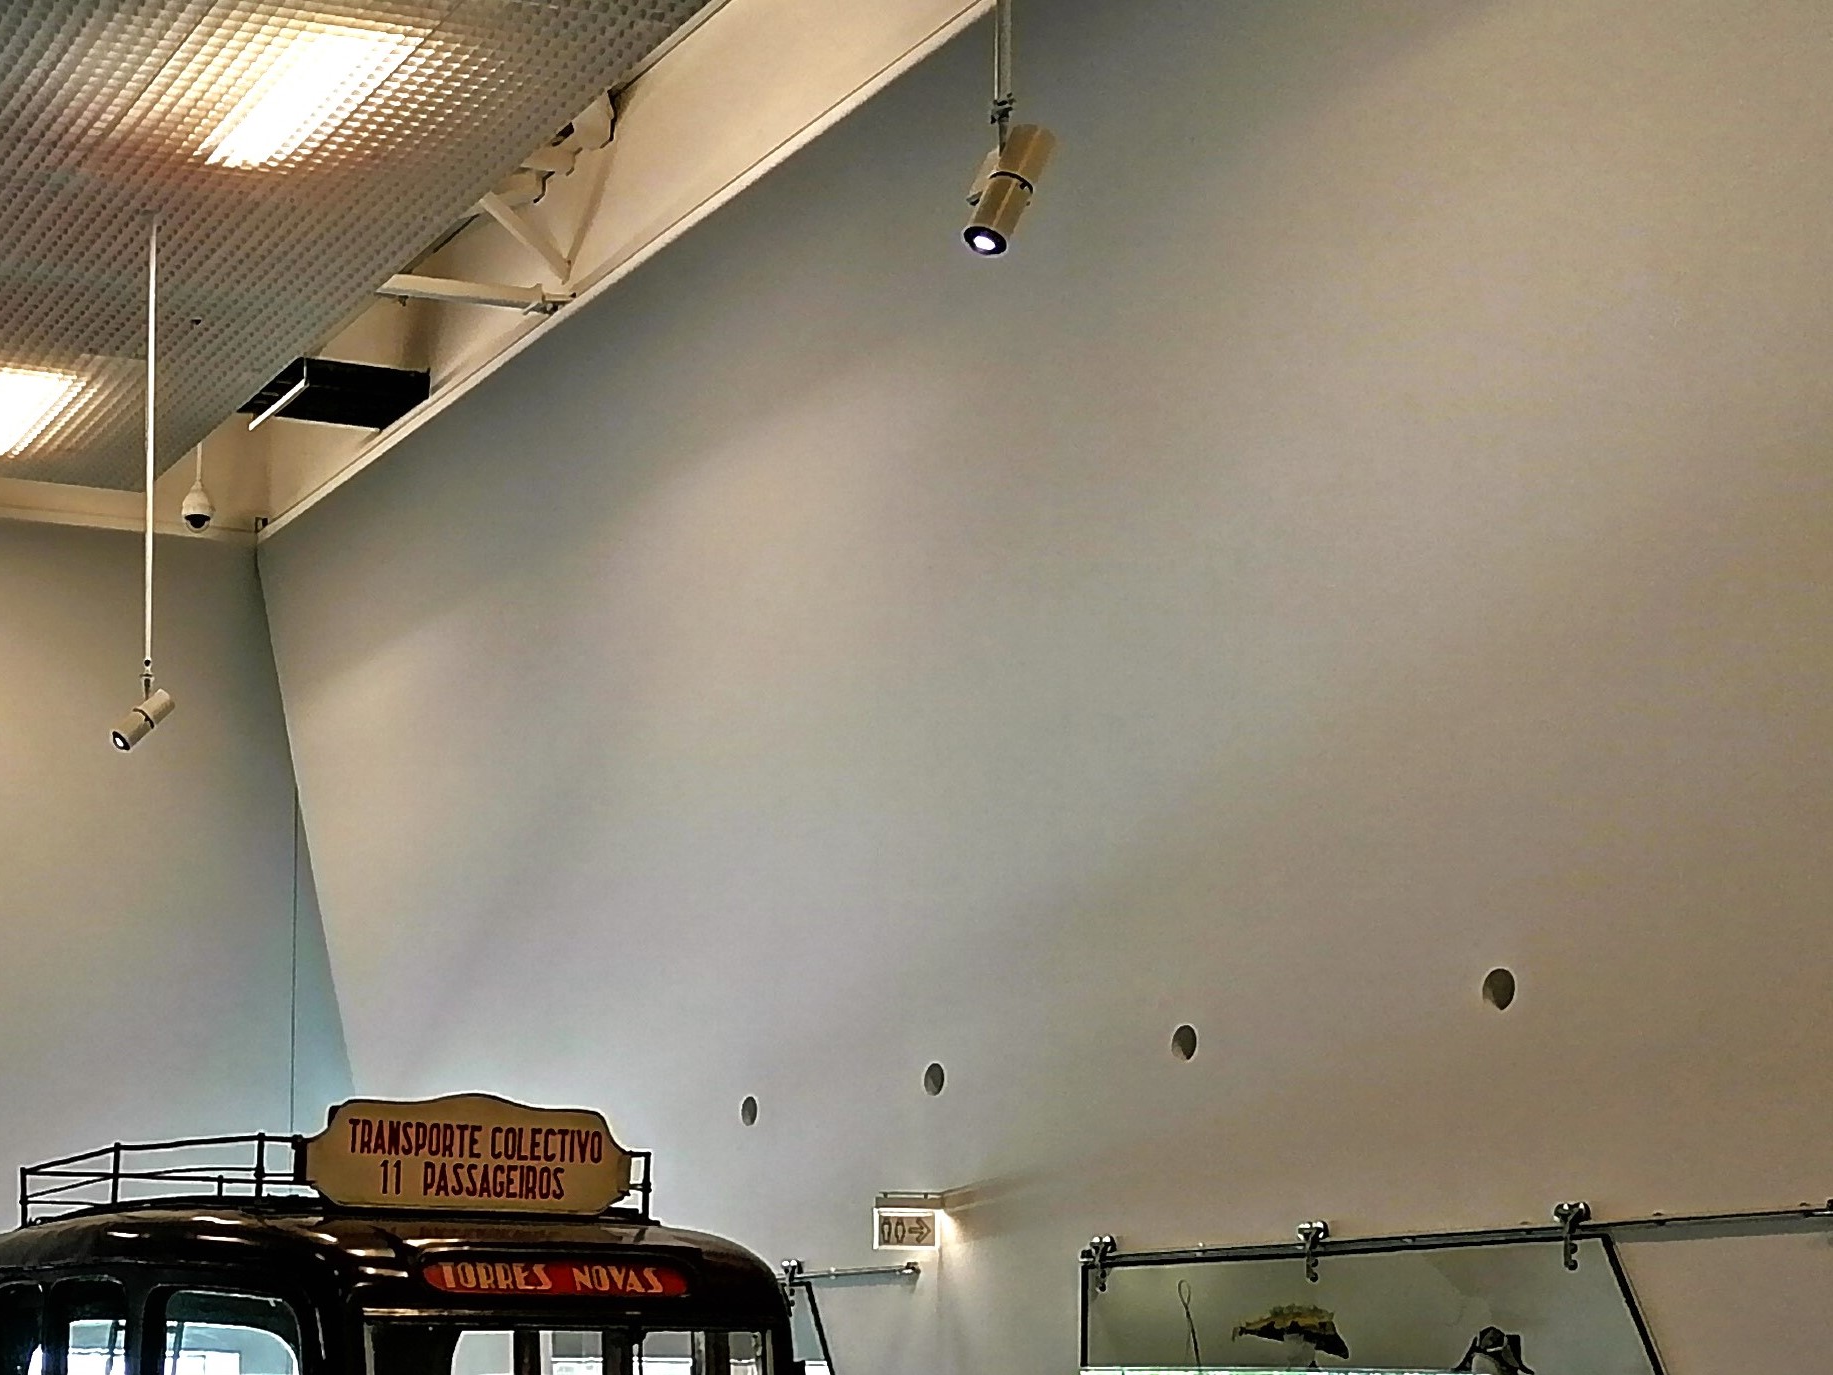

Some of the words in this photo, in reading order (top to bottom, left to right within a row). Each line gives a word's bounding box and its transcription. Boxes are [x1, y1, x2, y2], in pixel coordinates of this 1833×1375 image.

[348, 1118, 482, 1158] TRANSPORTE
[491, 1126, 603, 1164] COLECTIVO
[380, 1159, 402, 1195] 11
[423, 1160, 565, 1200] PASSAGEIROS
[438, 1262, 553, 1290] TORRES
[572, 1265, 664, 1293] NOVAS
